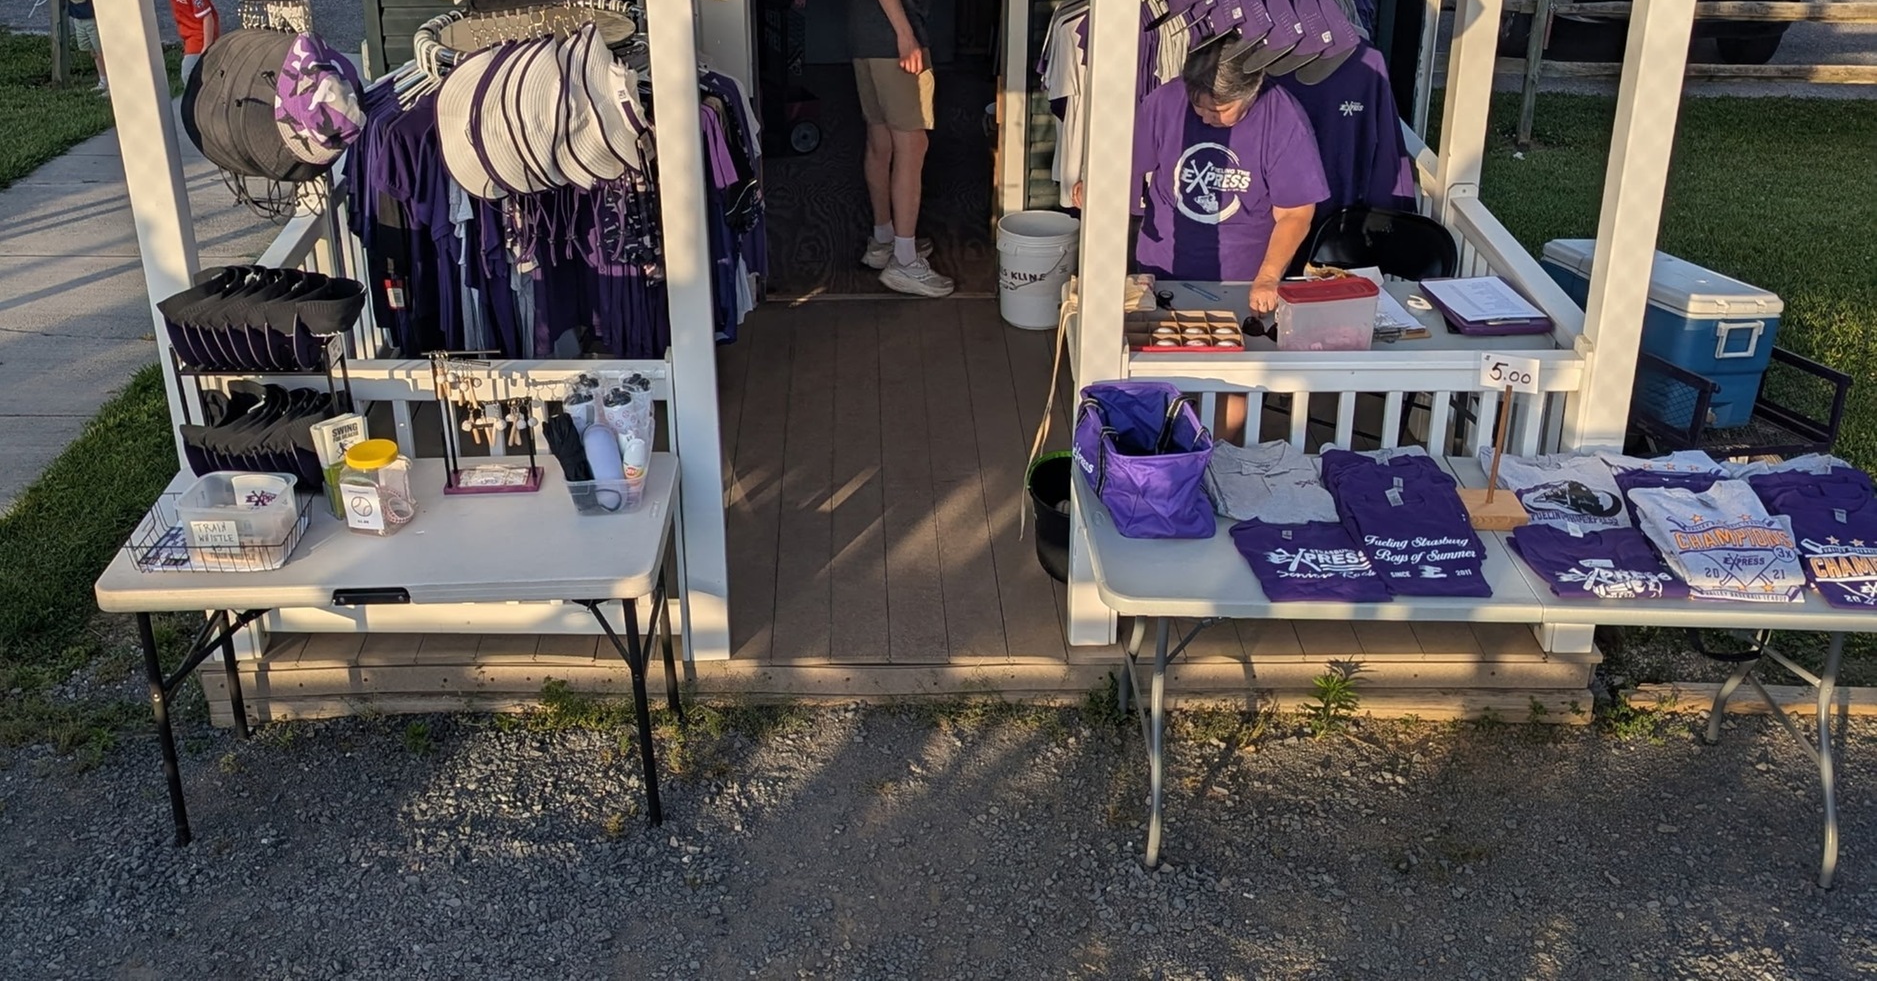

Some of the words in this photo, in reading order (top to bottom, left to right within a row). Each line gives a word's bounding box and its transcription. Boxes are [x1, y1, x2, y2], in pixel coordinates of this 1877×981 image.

[1181, 159, 1252, 195] EXPRESS
[1011, 271, 1047, 283] KLINE
[1489, 362, 1531, 384] 5.00
[332, 422, 358, 438] SWING
[194, 522, 227, 533] TRAIN
[198, 534, 234, 543] WHISTLE
[1364, 534, 1408, 550] Fueling
[1411, 536, 1469, 547] Strasburg
[1674, 529, 1795, 551] CHAMPIONS
[1374, 548, 1409, 565] Boys
[1410, 551, 1426, 564] of
[1426, 549, 1477, 562] Summer
[1723, 553, 1765, 572] EXPRESS
[1704, 567, 1720, 579] 20
[1772, 568, 1787, 580] 21
